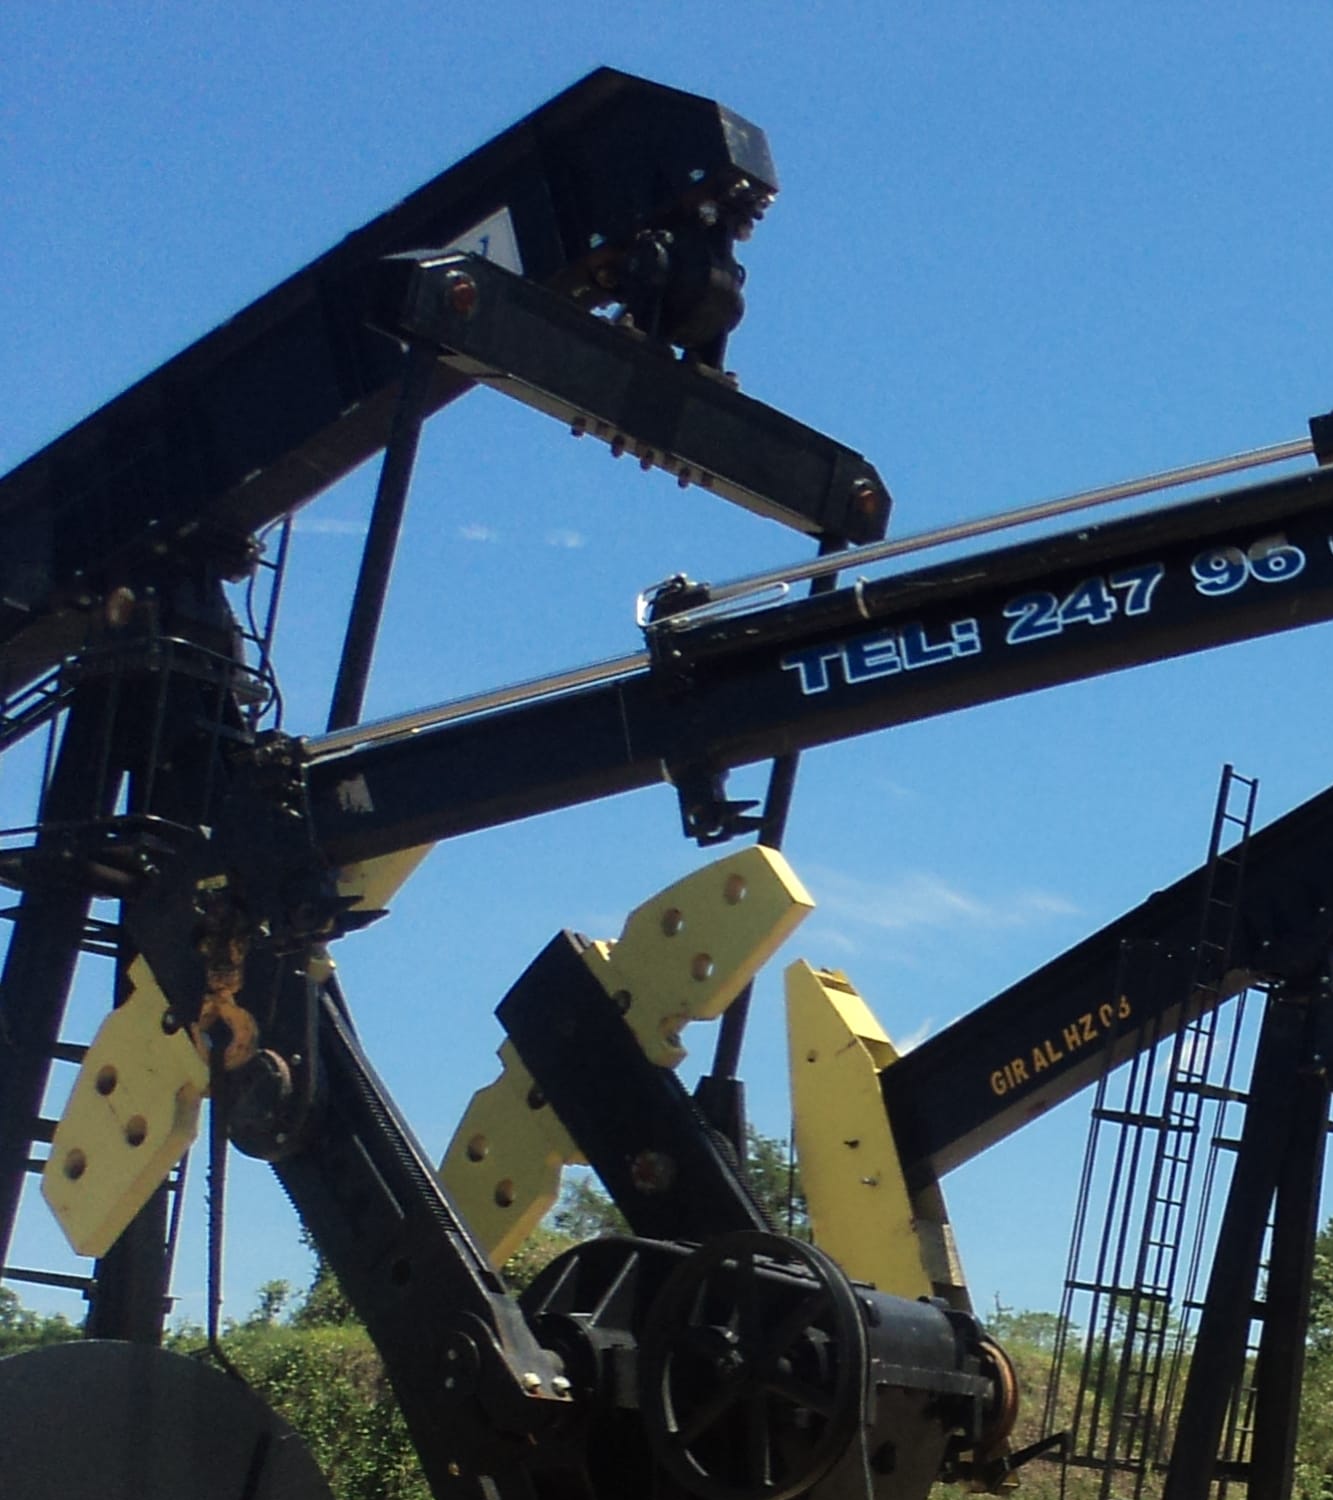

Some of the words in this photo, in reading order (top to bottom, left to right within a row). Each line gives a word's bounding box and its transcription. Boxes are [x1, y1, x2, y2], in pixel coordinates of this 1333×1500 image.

[781, 618, 981, 695] TEL:
[1002, 563, 1165, 644] 247
[1191, 540, 1306, 596] 96
